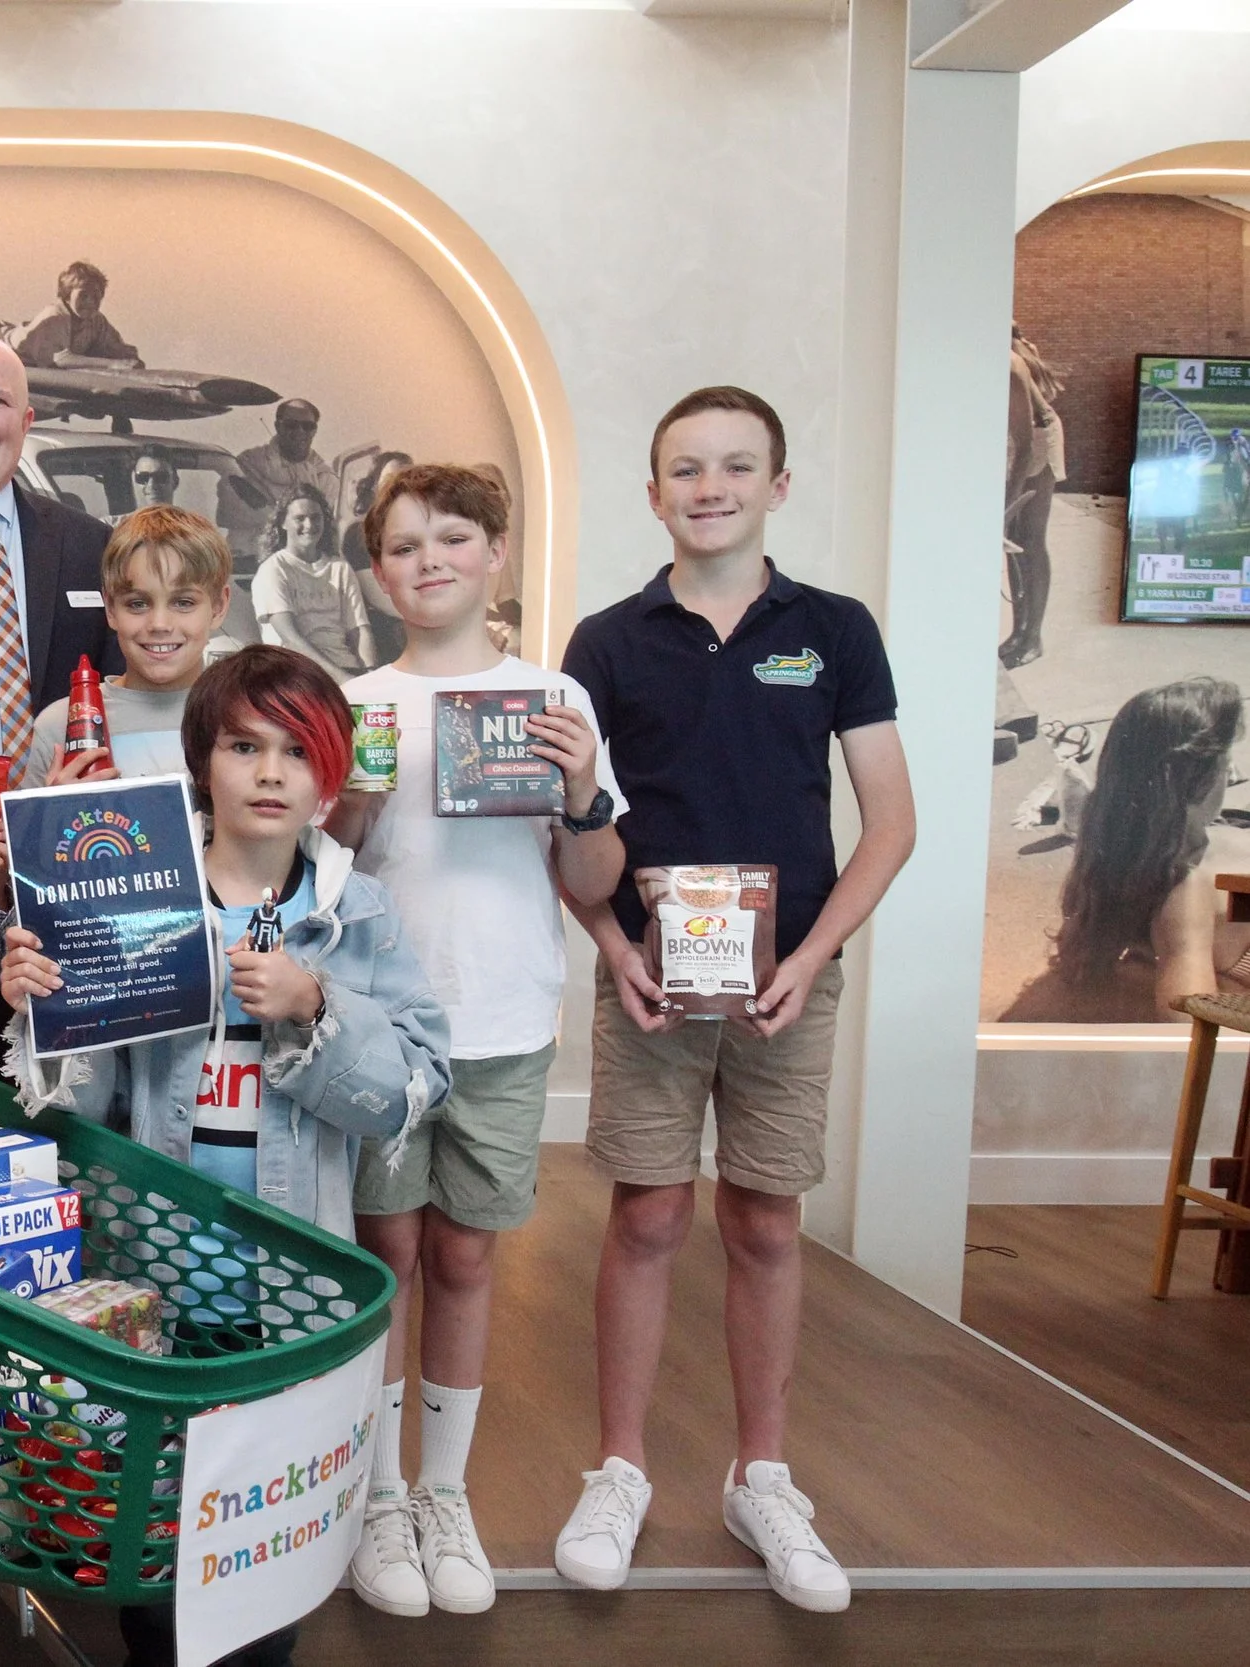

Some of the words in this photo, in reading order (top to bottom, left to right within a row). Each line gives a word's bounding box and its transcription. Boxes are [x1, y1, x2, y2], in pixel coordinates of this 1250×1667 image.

[1153, 369, 1173, 378] TAB
[1184, 366, 1196, 384] 4
[1210, 367, 1242, 377] TAREE
[1148, 590, 1175, 598] YARRA
[1176, 590, 1207, 598] VALLEY
[550, 691, 556, 700] 6
[367, 714, 395, 726] Edgel
[482, 716, 543, 742] NU
[367, 749, 384, 758] BABY
[498, 746, 534, 759] BARS
[514, 764, 541, 772] Coated
[56, 808, 151, 862] snacktember
[742, 872, 770, 881] FAMILY
[36, 876, 128, 905] DONATIONS
[134, 869, 180, 892] HERE!
[54, 920, 81, 928] Please
[65, 929, 93, 938] snacks
[95, 927, 110, 935] and
[59, 942, 71, 950] for
[73, 940, 90, 949] kids
[92, 938, 109, 946] who
[668, 939, 744, 957] BROWN
[73, 955, 101, 965] accept
[104, 954, 118, 962] any
[76, 967, 103, 976] sealed
[105, 964, 121, 972] and
[123, 962, 137, 971] still
[140, 960, 162, 970] good.
[66, 982, 102, 993] Together
[118, 979, 133, 988] can
[135, 975, 157, 984] make
[66, 997, 89, 1006] every
[90, 993, 116, 1002] Aussie
[148, 985, 178, 994] snacks.
[61, 1194, 79, 1218] 72
[14, 1206, 53, 1234] PACK
[66, 1217, 79, 1227] BIX
[197, 1412, 375, 1531] Snacktember
[373, 1490, 395, 1498] adidas
[202, 1509, 330, 1585] Donations
